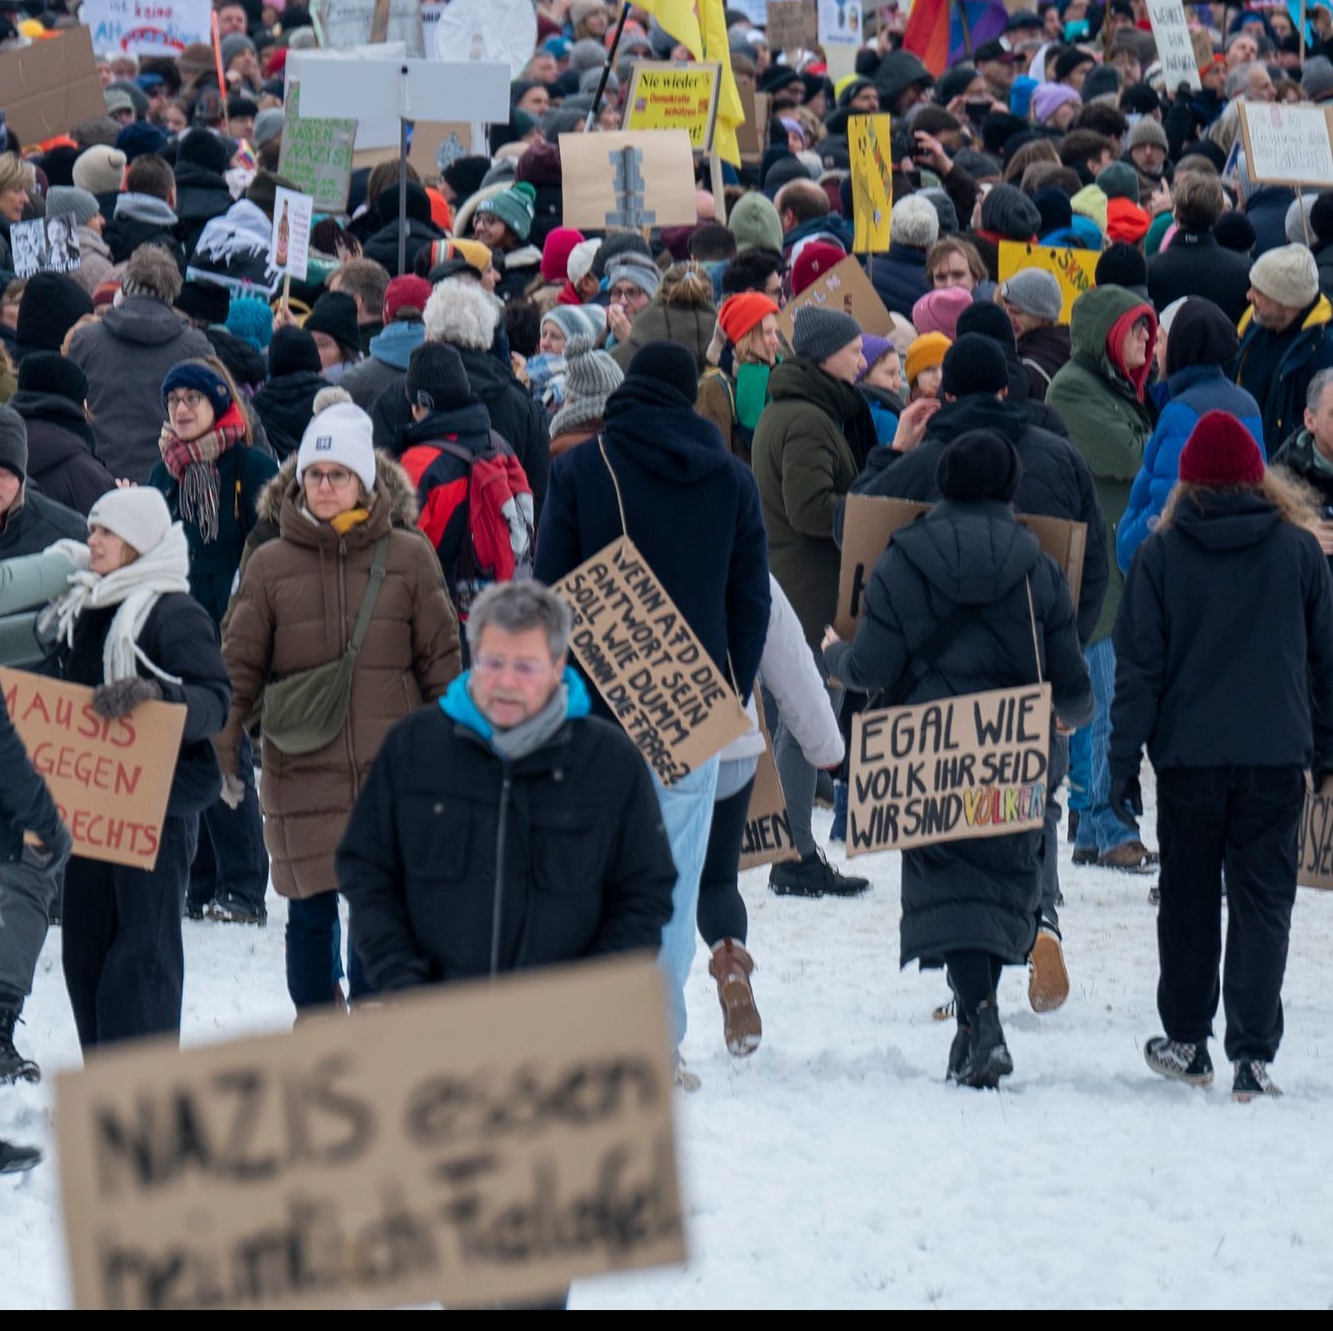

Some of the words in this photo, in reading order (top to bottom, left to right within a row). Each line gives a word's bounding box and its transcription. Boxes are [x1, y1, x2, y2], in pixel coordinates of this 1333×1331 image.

[640, 73, 660, 90] Nie
[663, 71, 700, 90] wieder
[564, 574, 607, 626] SOLL
[601, 620, 640, 670] WIE
[628, 666, 691, 748] DUMM
[587, 560, 674, 669] ANTWORT
[661, 671, 710, 729] SEIN
[612, 543, 668, 614] WENN
[653, 612, 700, 666] AFD
[689, 664, 727, 710] DIE
[572, 630, 618, 687] DANN
[605, 684, 637, 720] DIE
[627, 708, 692, 788] FRAGE?
[859, 701, 960, 765] EGAL
[972, 692, 1042, 747] WIE
[33, 741, 143, 795] GEGEN
[850, 803, 900, 850] WIR
[901, 793, 963, 837] SIND
[854, 760, 927, 805] VOLK
[933, 753, 977, 792] IHR
[978, 749, 1047, 786] SEID
[88, 1054, 379, 1200] NAZIS
[401, 1052, 662, 1151] essen
